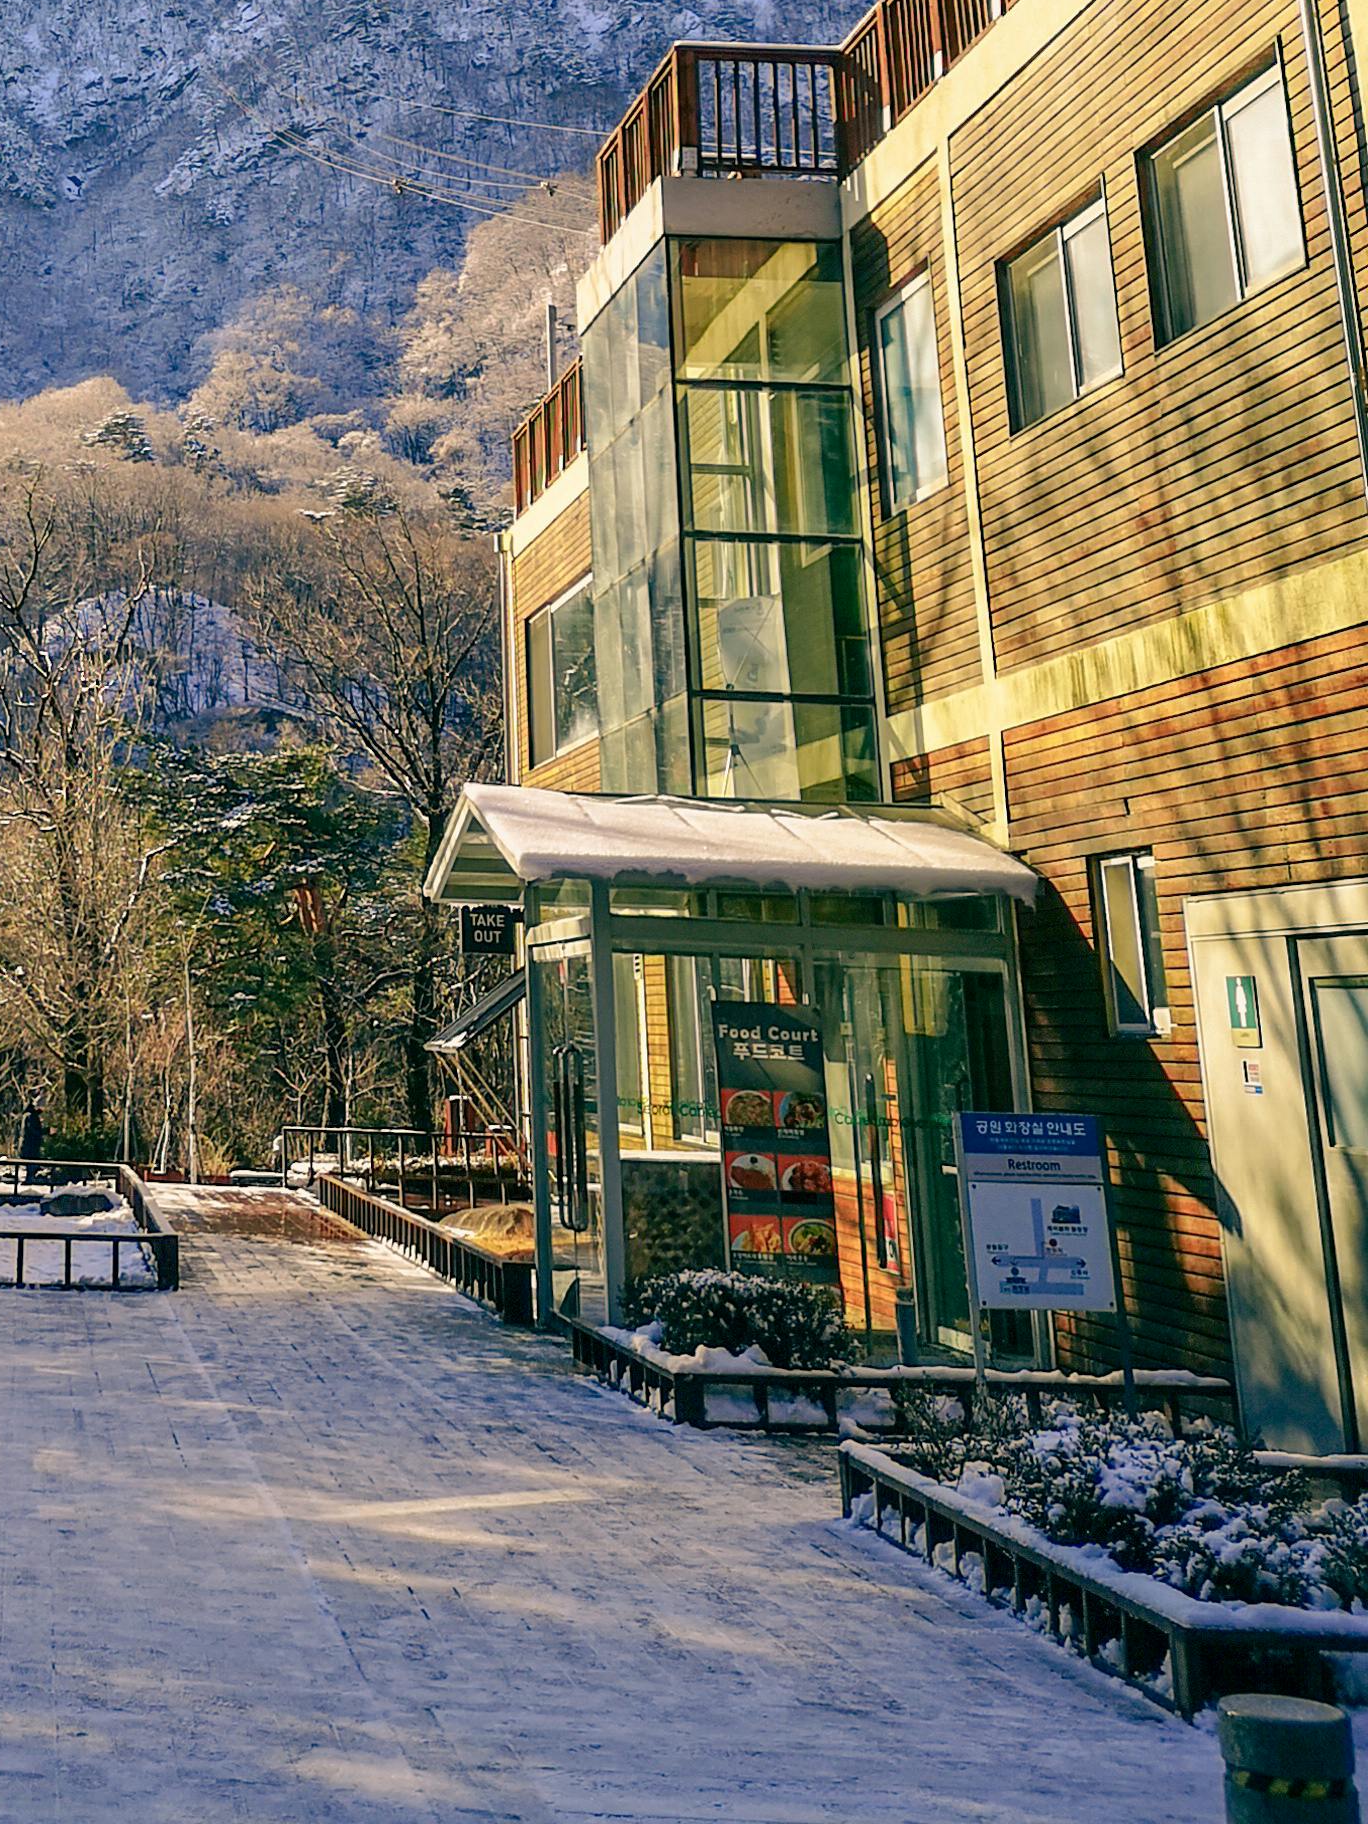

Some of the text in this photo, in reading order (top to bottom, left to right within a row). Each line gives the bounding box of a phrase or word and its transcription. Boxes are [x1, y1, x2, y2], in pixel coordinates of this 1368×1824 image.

[469, 913, 505, 927] TAKE
[473, 929, 502, 944] OUT
[718, 1024, 819, 1042] Food Court
[733, 1042, 806, 1061] 푸드코트
[1005, 1120, 1044, 1136] 화장실
[1046, 1122, 1087, 1136] 안내도
[1007, 1159, 1061, 1171] Restroom
